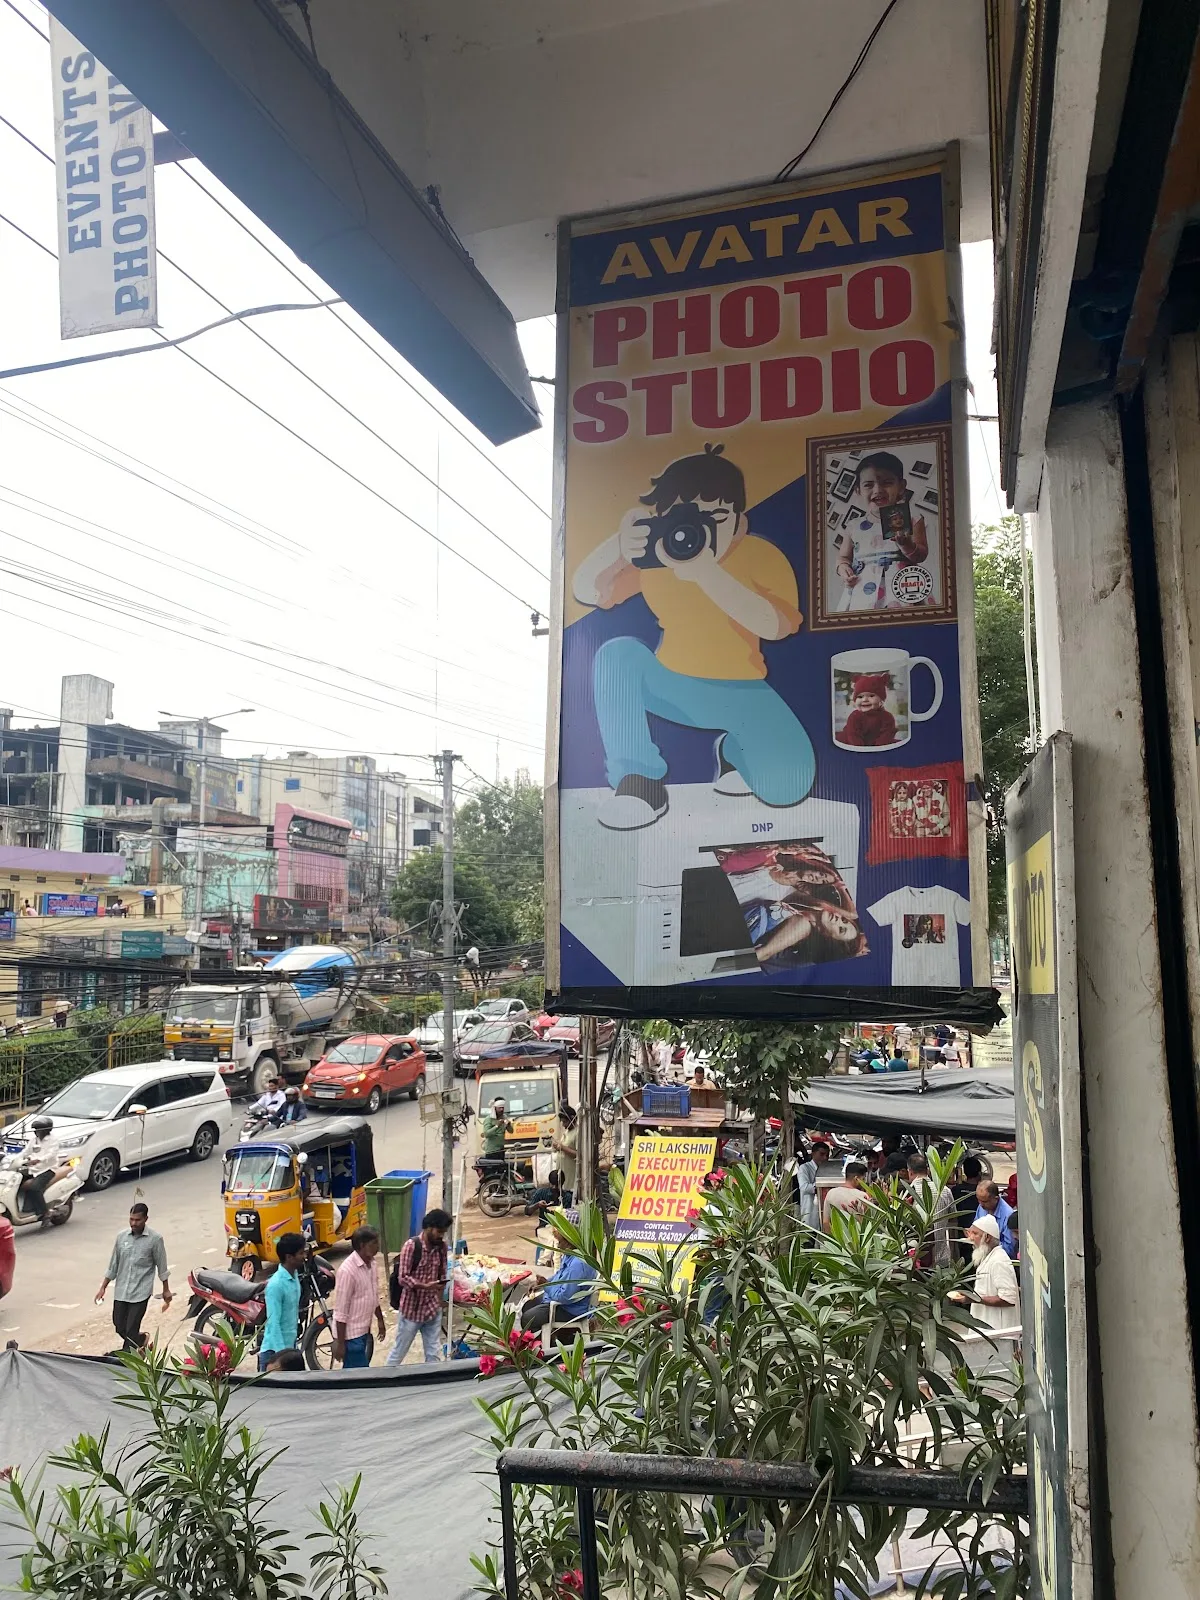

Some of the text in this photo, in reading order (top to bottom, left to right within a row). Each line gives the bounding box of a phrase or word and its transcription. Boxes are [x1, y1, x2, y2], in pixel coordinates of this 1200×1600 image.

[61, 51, 102, 254] EVENTS
[599, 195, 914, 286] AVATAR
[592, 265, 912, 369] PHOTO
[571, 339, 935, 444] STUDIO
[751, 822, 774, 833] DNP
[637, 1141, 712, 1155] SRI LAKSHMI
[637, 1157, 707, 1172] EXECUTIVE
[643, 1222, 674, 1231] CONTACT
